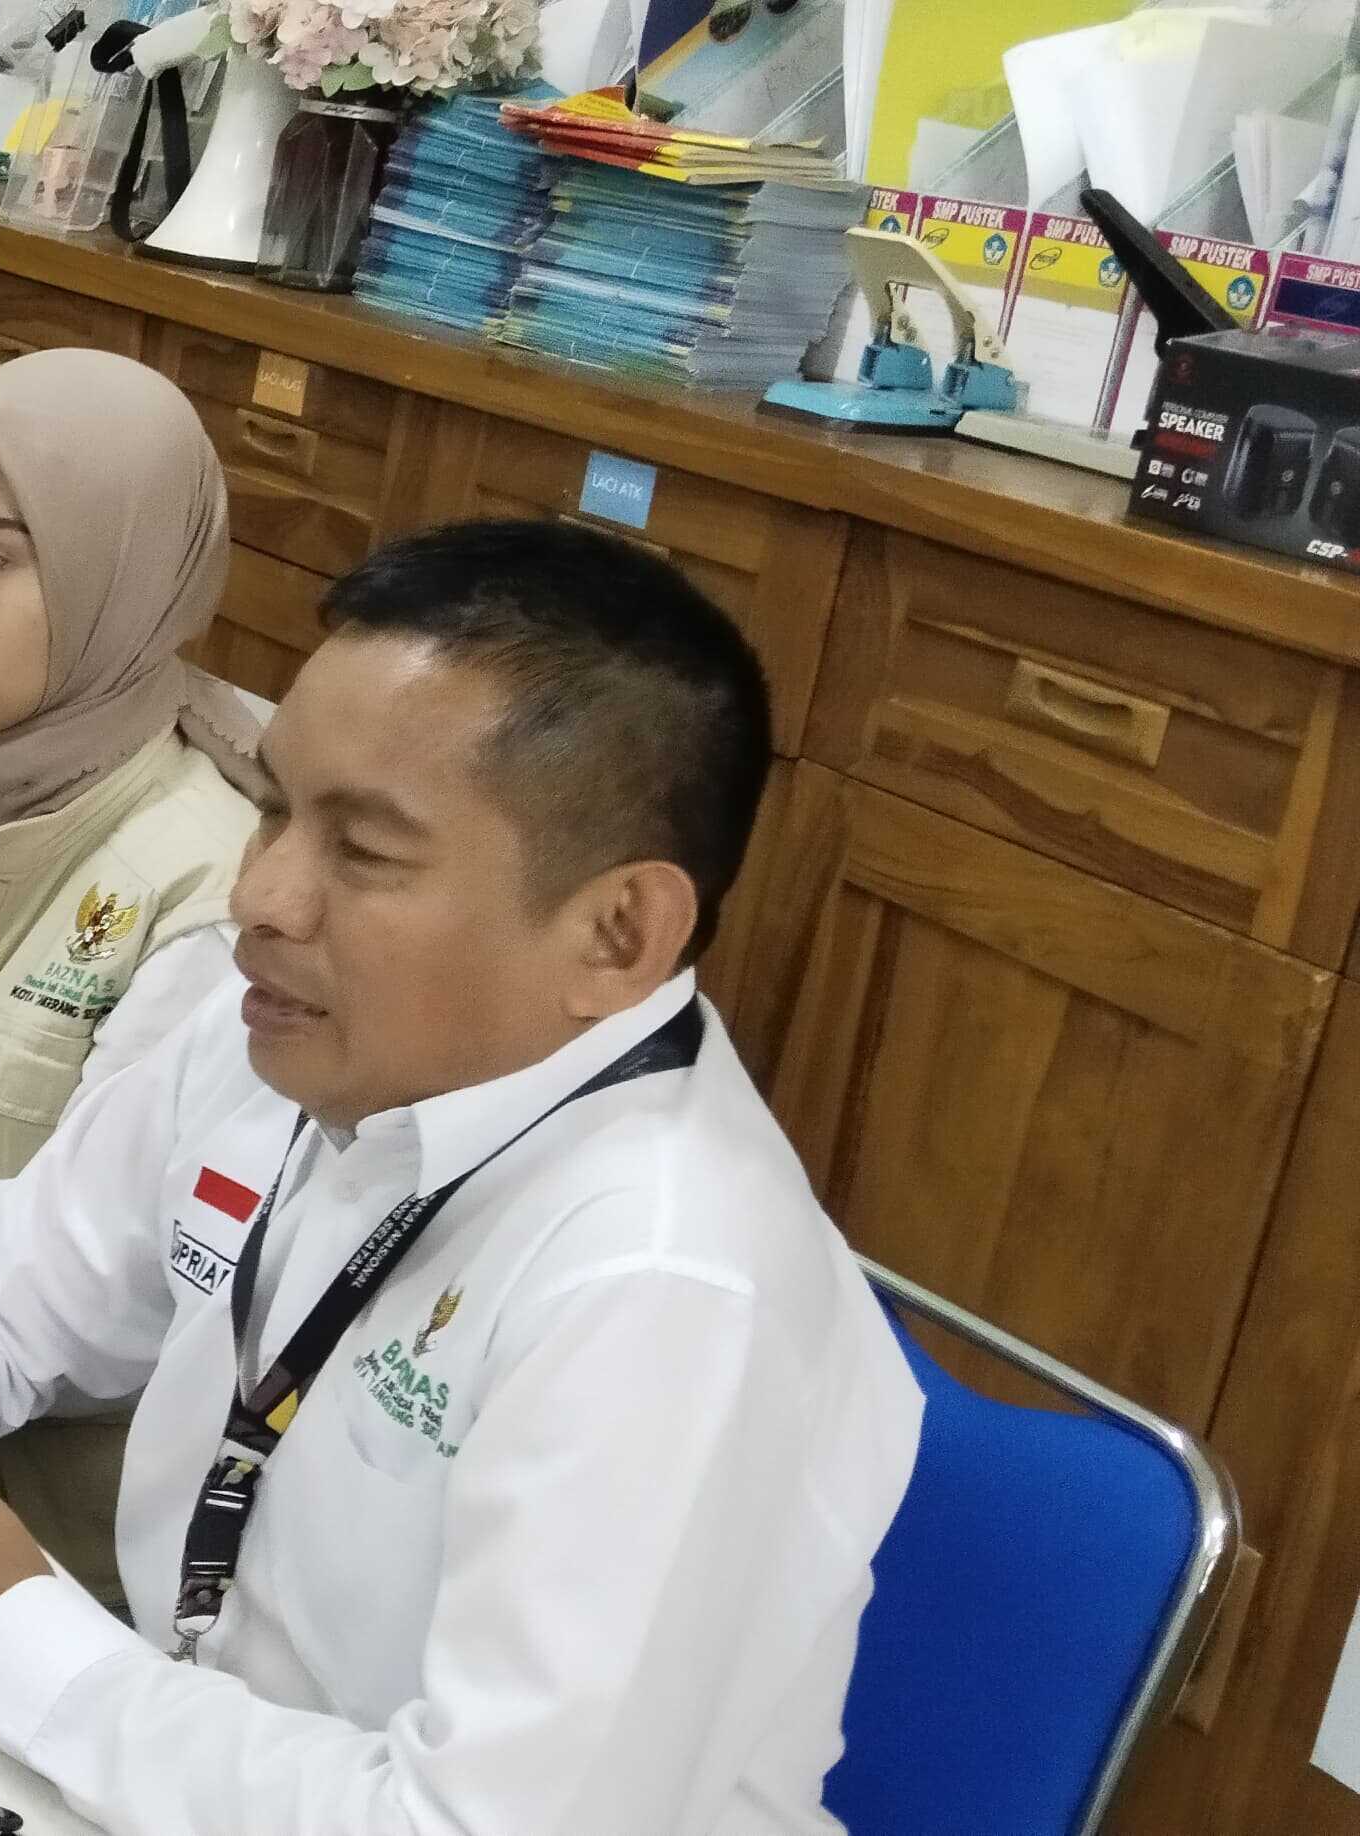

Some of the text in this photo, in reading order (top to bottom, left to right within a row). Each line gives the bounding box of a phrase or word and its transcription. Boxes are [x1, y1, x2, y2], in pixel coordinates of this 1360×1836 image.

[870, 189, 900, 211] STEK
[933, 199, 1007, 229] SMP PUSTEK
[1044, 217, 1073, 240] SMP
[1169, 236, 1256, 270] SMP PUSTEK
[1306, 264, 1360, 289] SMP PUST
[1158, 411, 1225, 441] SPEAKER
[44, 961, 116, 992] BAZNAS
[347, 1219, 395, 1275] SELATAN
[351, 1229, 402, 1288] NASIONAL
